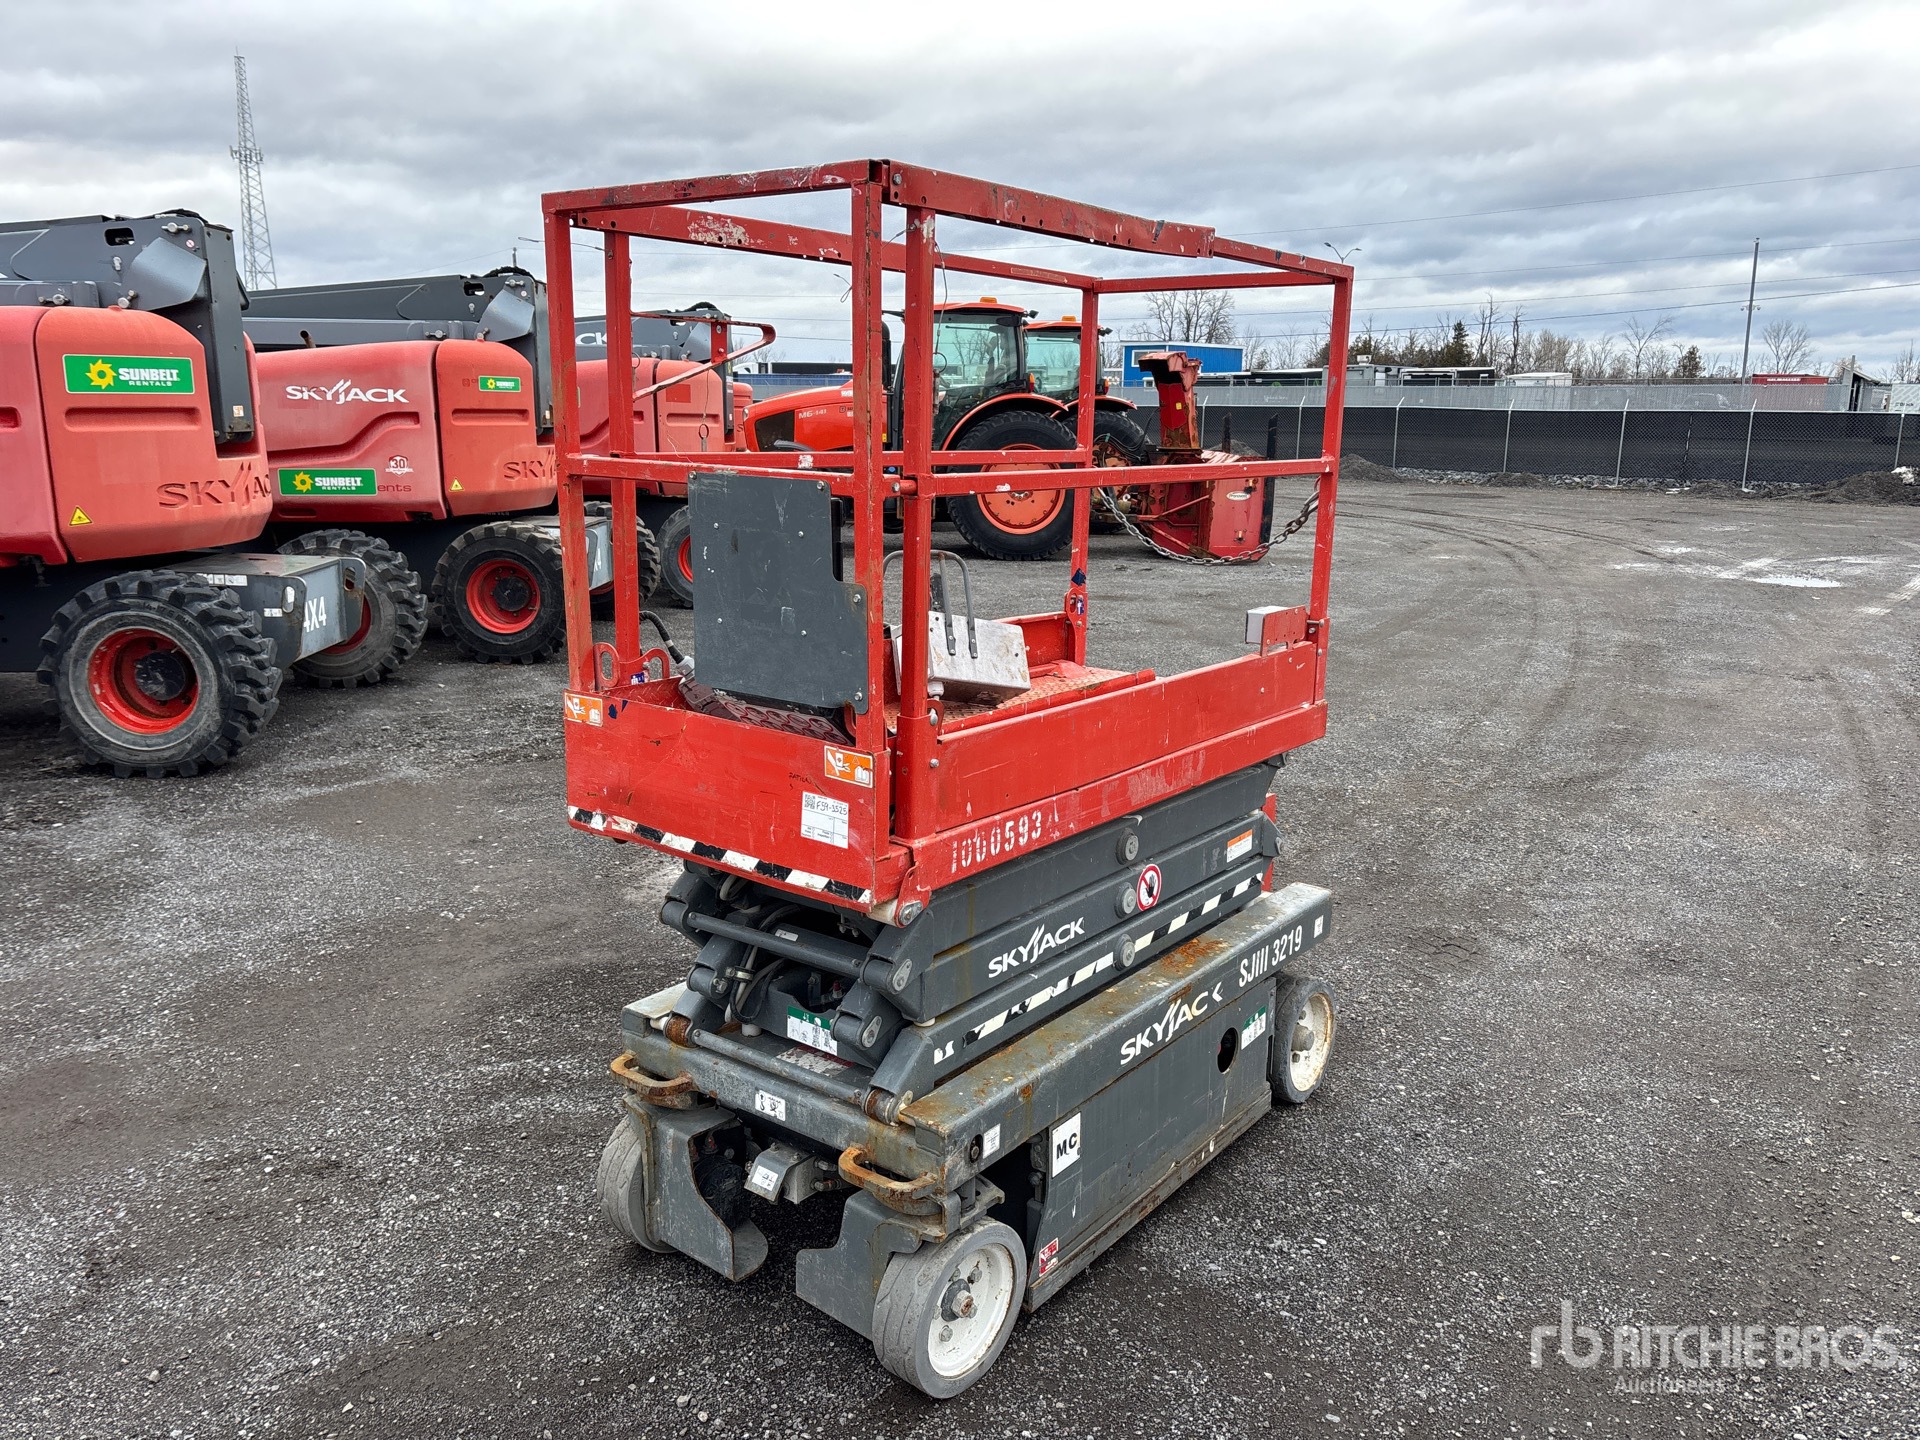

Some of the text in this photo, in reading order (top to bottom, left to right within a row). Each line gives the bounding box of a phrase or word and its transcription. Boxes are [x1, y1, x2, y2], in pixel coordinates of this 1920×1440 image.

[118, 367, 180, 381] SUNBELT
[285, 379, 410, 404] SKYJACK
[391, 458, 406, 469] 30
[314, 477, 362, 487] SUNBELT
[303, 596, 327, 633] 4X4
[951, 811, 1042, 874] 1000593
[988, 916, 1085, 979] SKYJACK
[1271, 925, 1303, 966] 3219
[1056, 1132, 1078, 1160] MC
